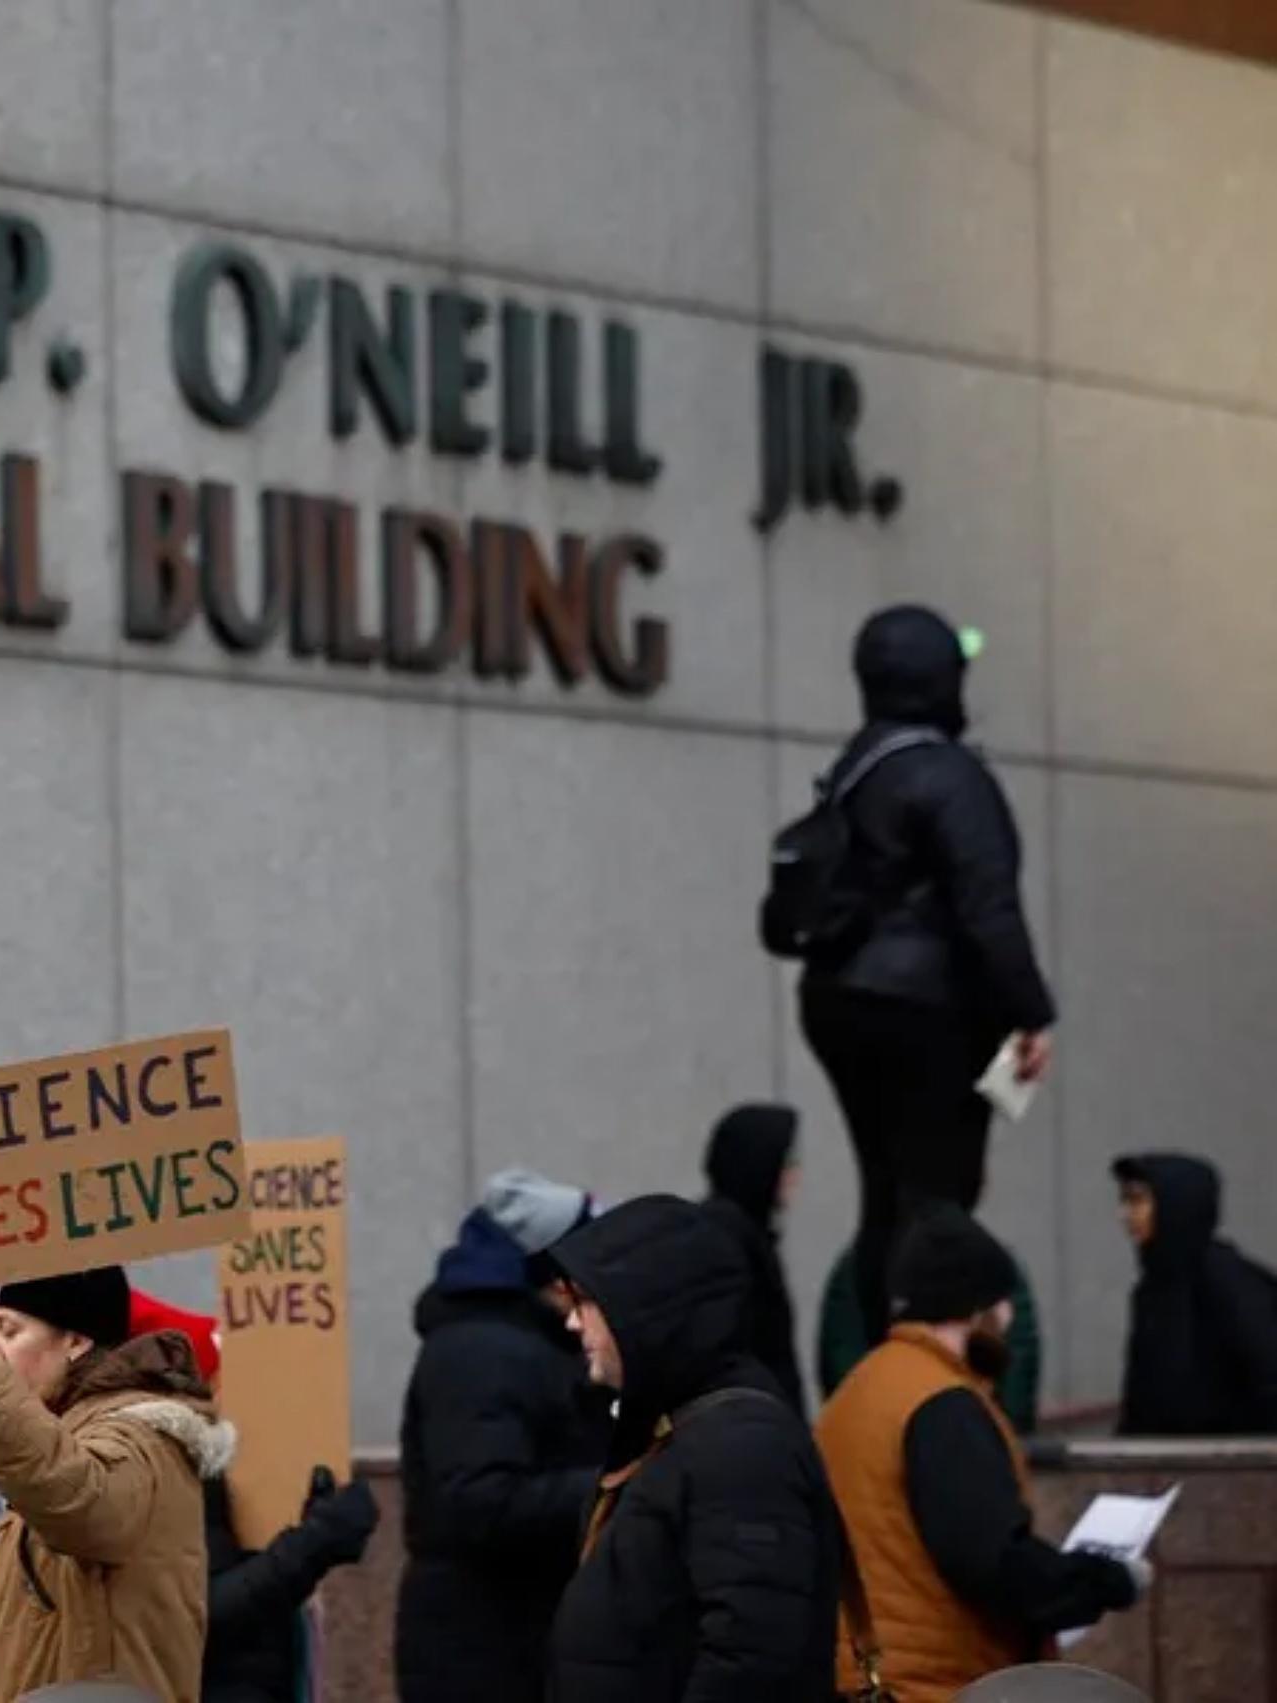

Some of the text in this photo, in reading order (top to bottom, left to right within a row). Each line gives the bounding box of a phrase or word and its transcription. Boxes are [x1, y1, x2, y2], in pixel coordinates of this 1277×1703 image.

[169, 240, 661, 486] O'NEILL
[750, 340, 903, 533] JR.
[123, 468, 669, 696] BUILDING
[58, 1139, 240, 1239] LIVES
[249, 1158, 344, 1210] CIENCE
[230, 1225, 326, 1274] SAVES
[224, 1282, 336, 1331] LIVES
